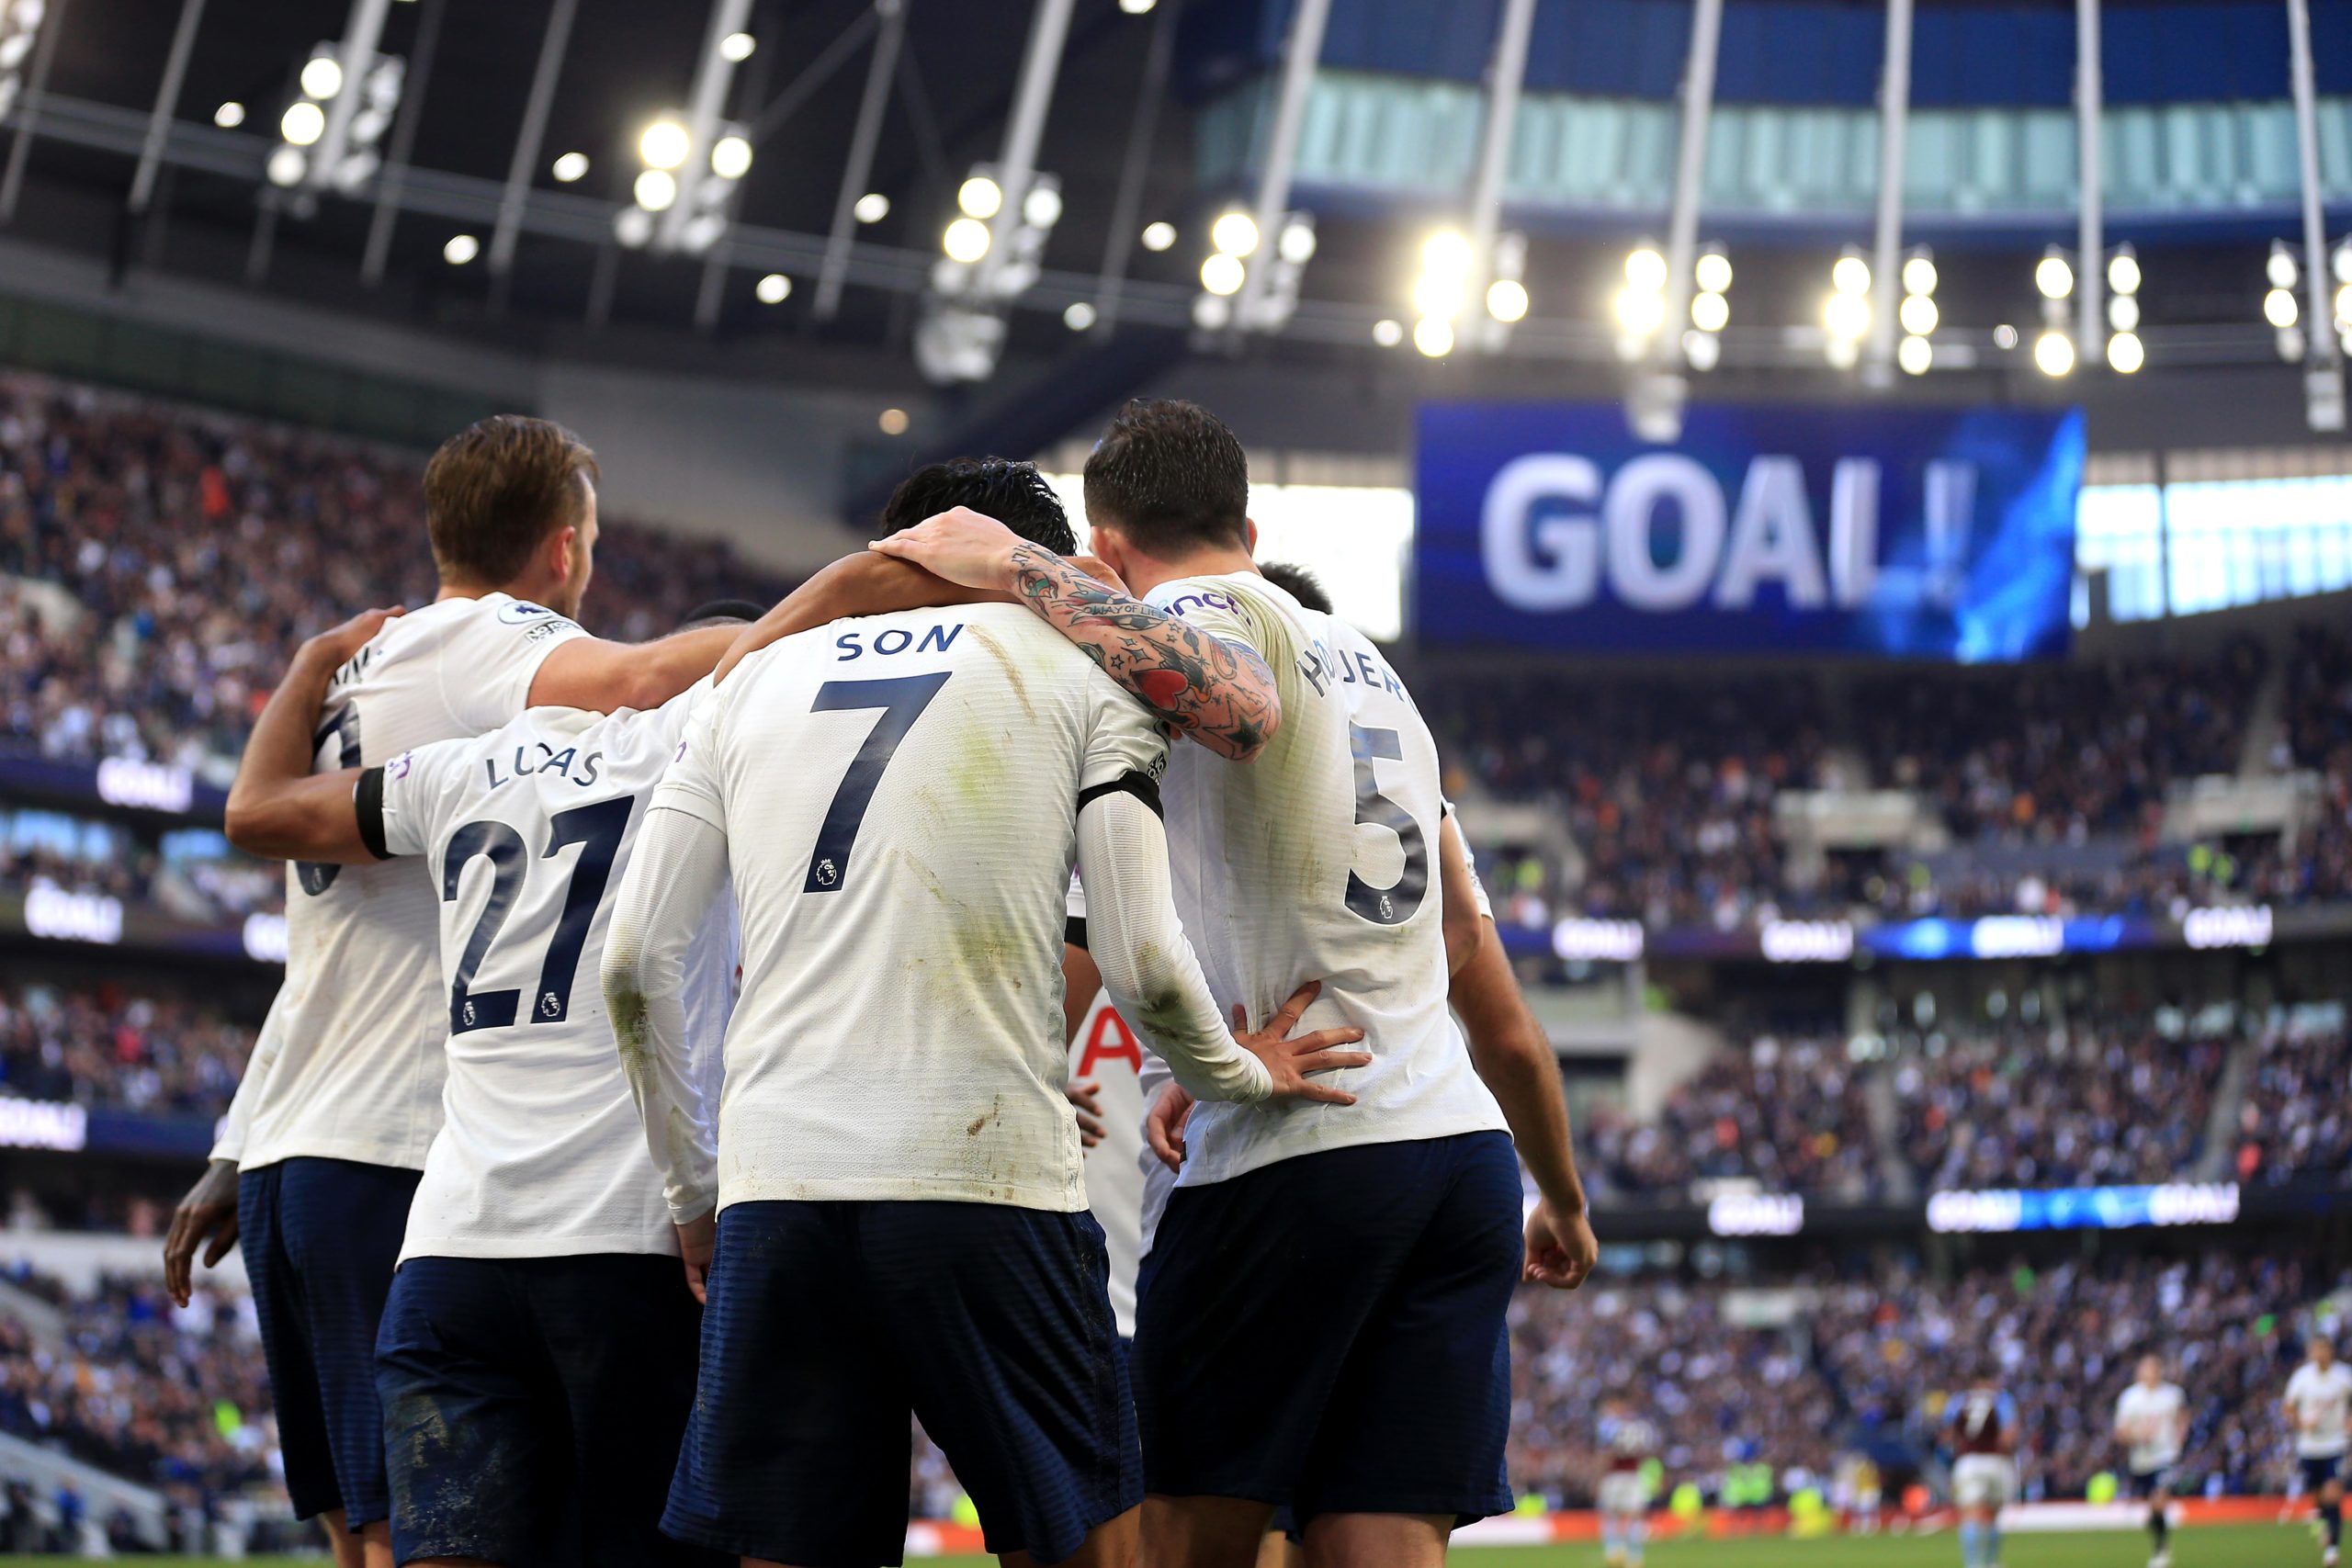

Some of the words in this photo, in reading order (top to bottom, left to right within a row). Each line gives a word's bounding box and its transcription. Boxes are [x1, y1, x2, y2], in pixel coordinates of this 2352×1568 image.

[836, 624, 964, 660] SON
[486, 742, 604, 789] LUAS
[802, 671, 953, 894] 7
[1343, 716, 1429, 926] 5
[444, 795, 635, 1036] 27
